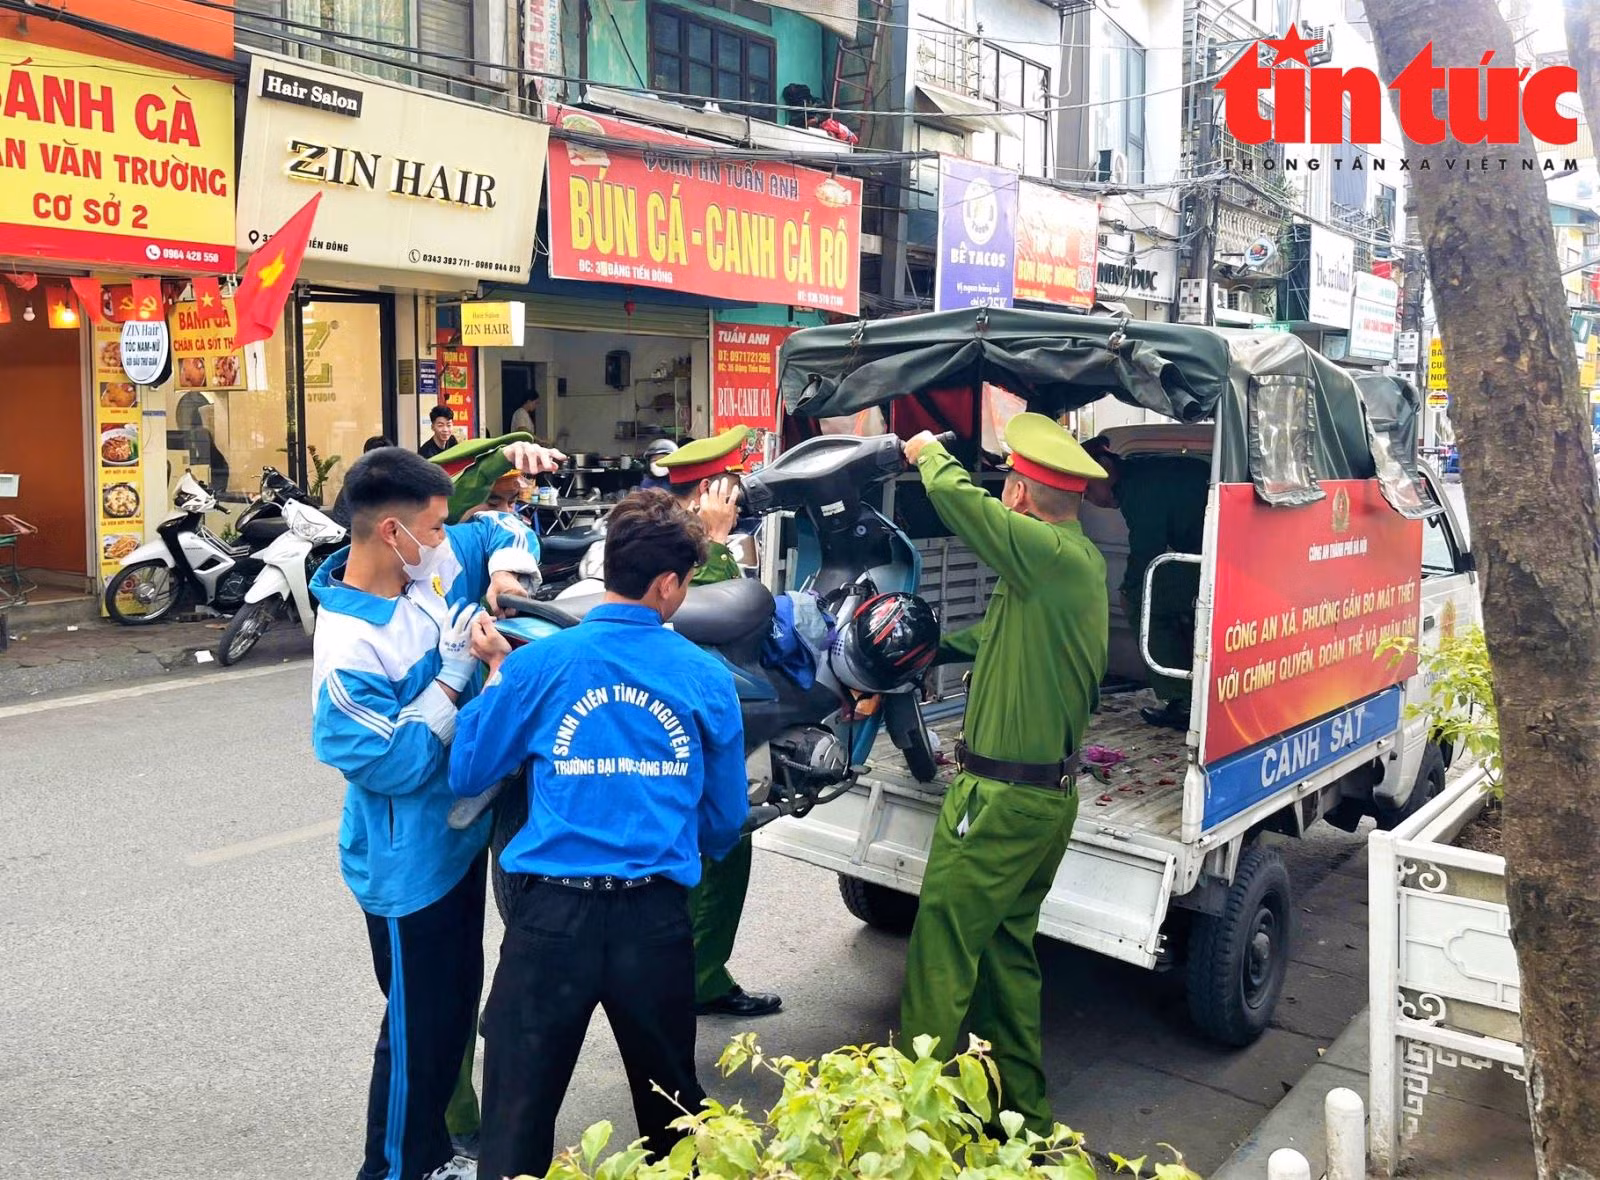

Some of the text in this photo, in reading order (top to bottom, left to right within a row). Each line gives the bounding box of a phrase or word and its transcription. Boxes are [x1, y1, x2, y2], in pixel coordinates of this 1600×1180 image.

[0, 57, 200, 147] ÁNH GÀ
[267, 75, 358, 111] Hair Salon
[40, 138, 102, 180] VĂN
[114, 154, 227, 197] TRƯỜNG
[288, 139, 497, 209] ZIN HAIR
[725, 160, 765, 193] TUẤN
[769, 173, 799, 201] ANH
[33, 192, 148, 229] CƠ SỞ 2
[569, 166, 639, 258] BÚN
[647, 181, 689, 267] CÁ
[704, 202, 776, 280] CANH
[783, 209, 814, 285] CÁ
[820, 216, 849, 291] RÔ
[309, 236, 323, 249] IẾN
[326, 240, 349, 252] ĐÔNG
[968, 251, 1006, 268] TACOS
[632, 263, 650, 280] TIẾN
[652, 267, 673, 284] ĐÔNG
[141, 323, 160, 336] Hair
[465, 323, 510, 336] ZIN HAIR
[718, 325, 770, 346] TUẤN ANH
[761, 382, 771, 416] CÁ
[1225, 618, 1258, 653] CÔNG
[1261, 613, 1278, 643] AN
[1302, 598, 1340, 631] PHƯỜNG
[1217, 667, 1240, 703] VỚI
[1243, 659, 1276, 694] CHÍNH
[1318, 636, 1345, 668] ĐOÀN
[1366, 624, 1377, 651] VÀ
[552, 682, 691, 759] SINH VIÊN TÌNH NGUYỆN
[554, 757, 595, 776] TRƯỜNG
[597, 759, 616, 777] ĐẠI
[662, 760, 689, 777] ĐOÀN
